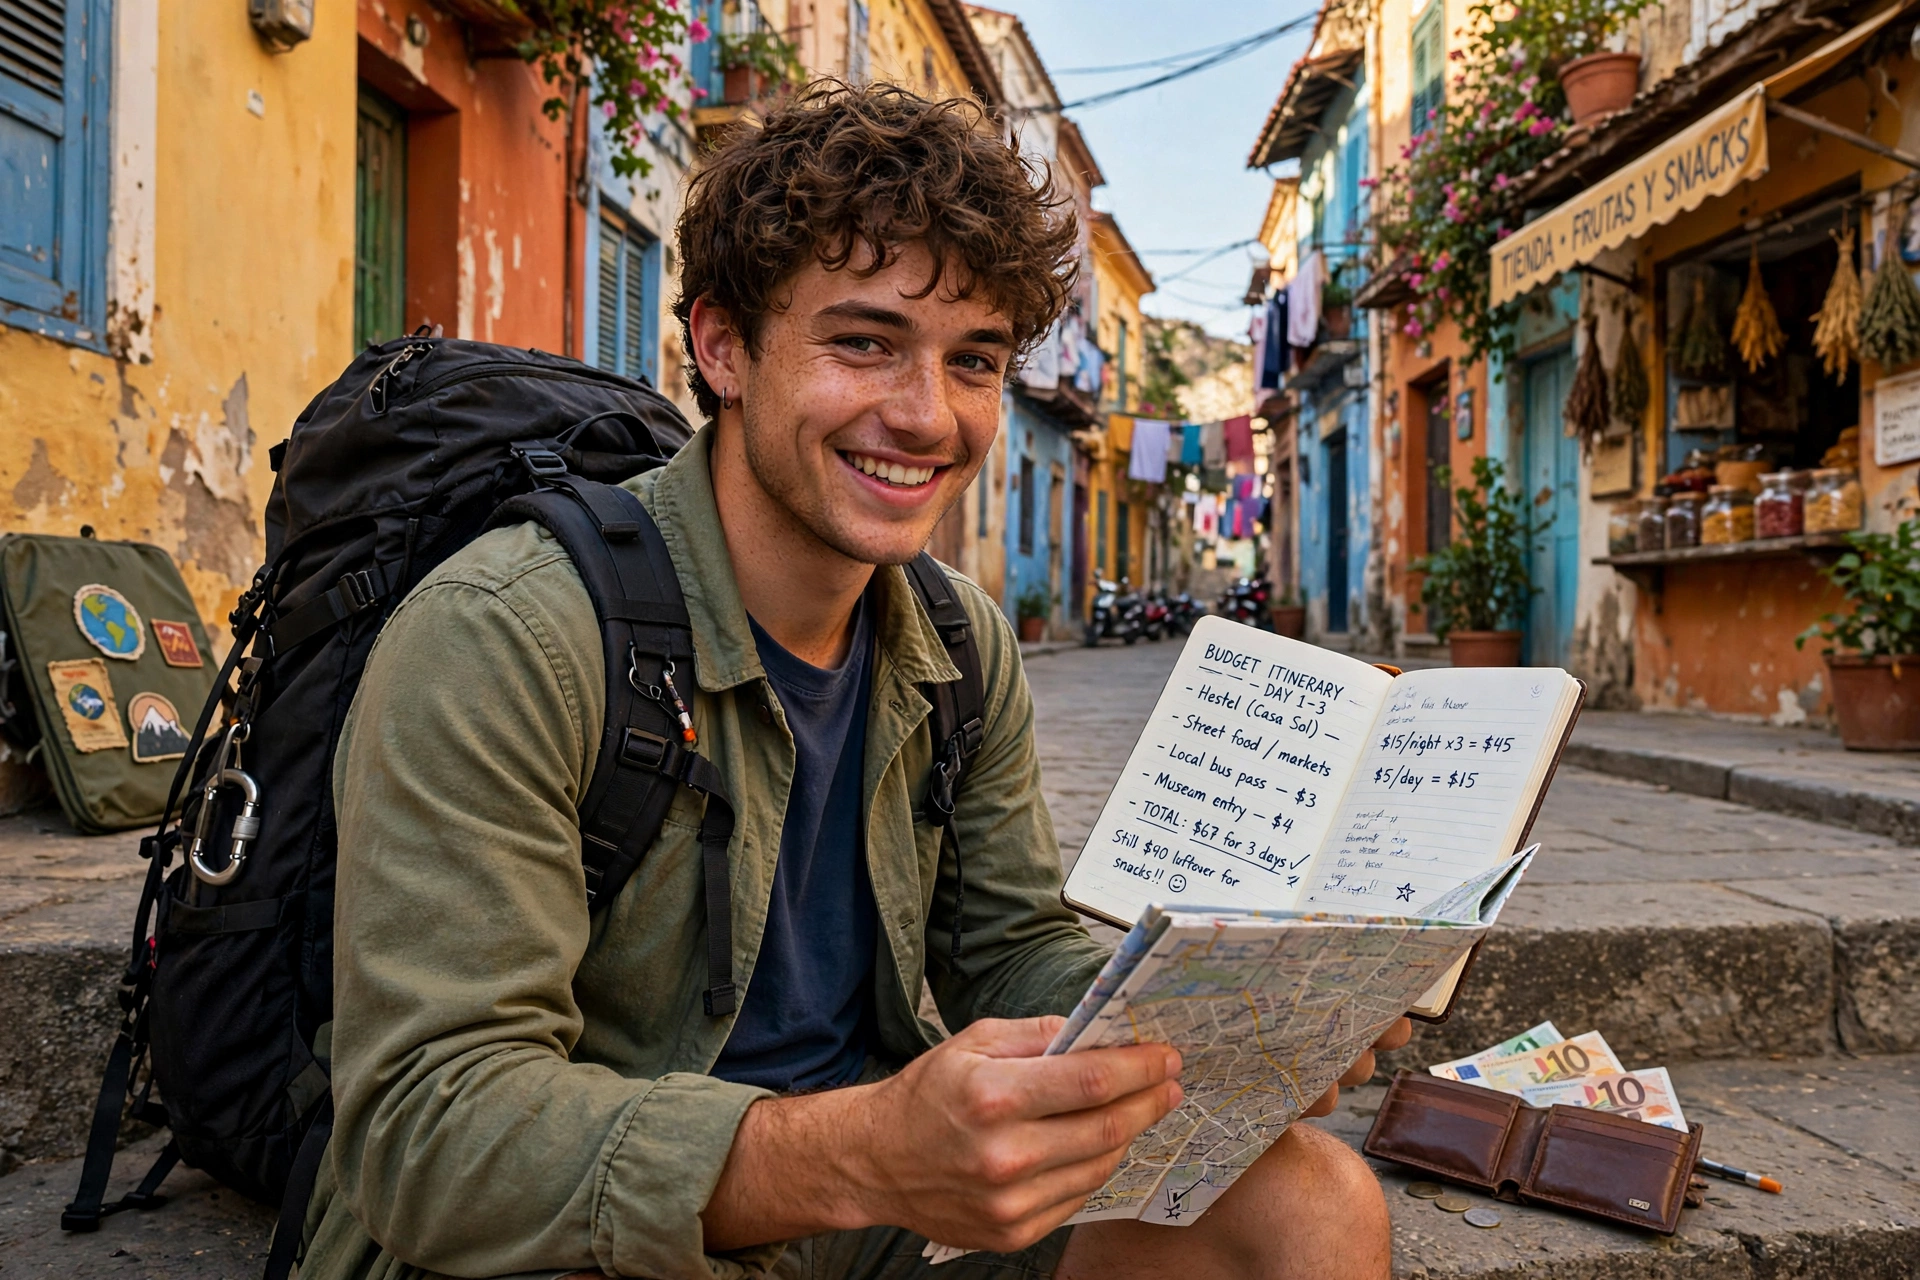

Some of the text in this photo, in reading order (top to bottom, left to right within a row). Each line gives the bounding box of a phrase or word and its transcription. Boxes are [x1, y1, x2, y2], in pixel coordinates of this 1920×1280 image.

[1501, 229, 1555, 288] TIENDA
[1572, 182, 1636, 252] FRUTAS
[1643, 169, 1657, 213] Y
[1664, 116, 1750, 202] SNACKS
[1204, 643, 1345, 701] BUDGET ITINERARY
[1246, 698, 1284, 726] (Casa
[1289, 715, 1319, 739] Sol)
[1263, 682, 1327, 715] DAY 1-3
[1182, 714, 1226, 739] Street
[1230, 728, 1263, 752] food
[1277, 751, 1332, 777] markets
[1444, 735, 1464, 751] x3
[1482, 734, 1516, 754] $45
[1168, 743, 1206, 768] Local
[1209, 755, 1233, 778] bus
[1234, 772, 1268, 790] pass
[1294, 787, 1317, 808] $3
[1447, 769, 1480, 789] $15
[1212, 795, 1247, 823] entry
[1271, 812, 1294, 835] $4
[1143, 800, 1188, 828] TOTAL:
[1192, 818, 1220, 841] $67
[1223, 830, 1243, 850] for
[1245, 841, 1257, 856] 3
[1258, 845, 1287, 872] days
[1112, 829, 1140, 849] Still
[1142, 839, 1169, 860] $90
[1220, 868, 1241, 887] for
[1546, 1044, 1590, 1075] 10
[1598, 1077, 1646, 1108] 10
